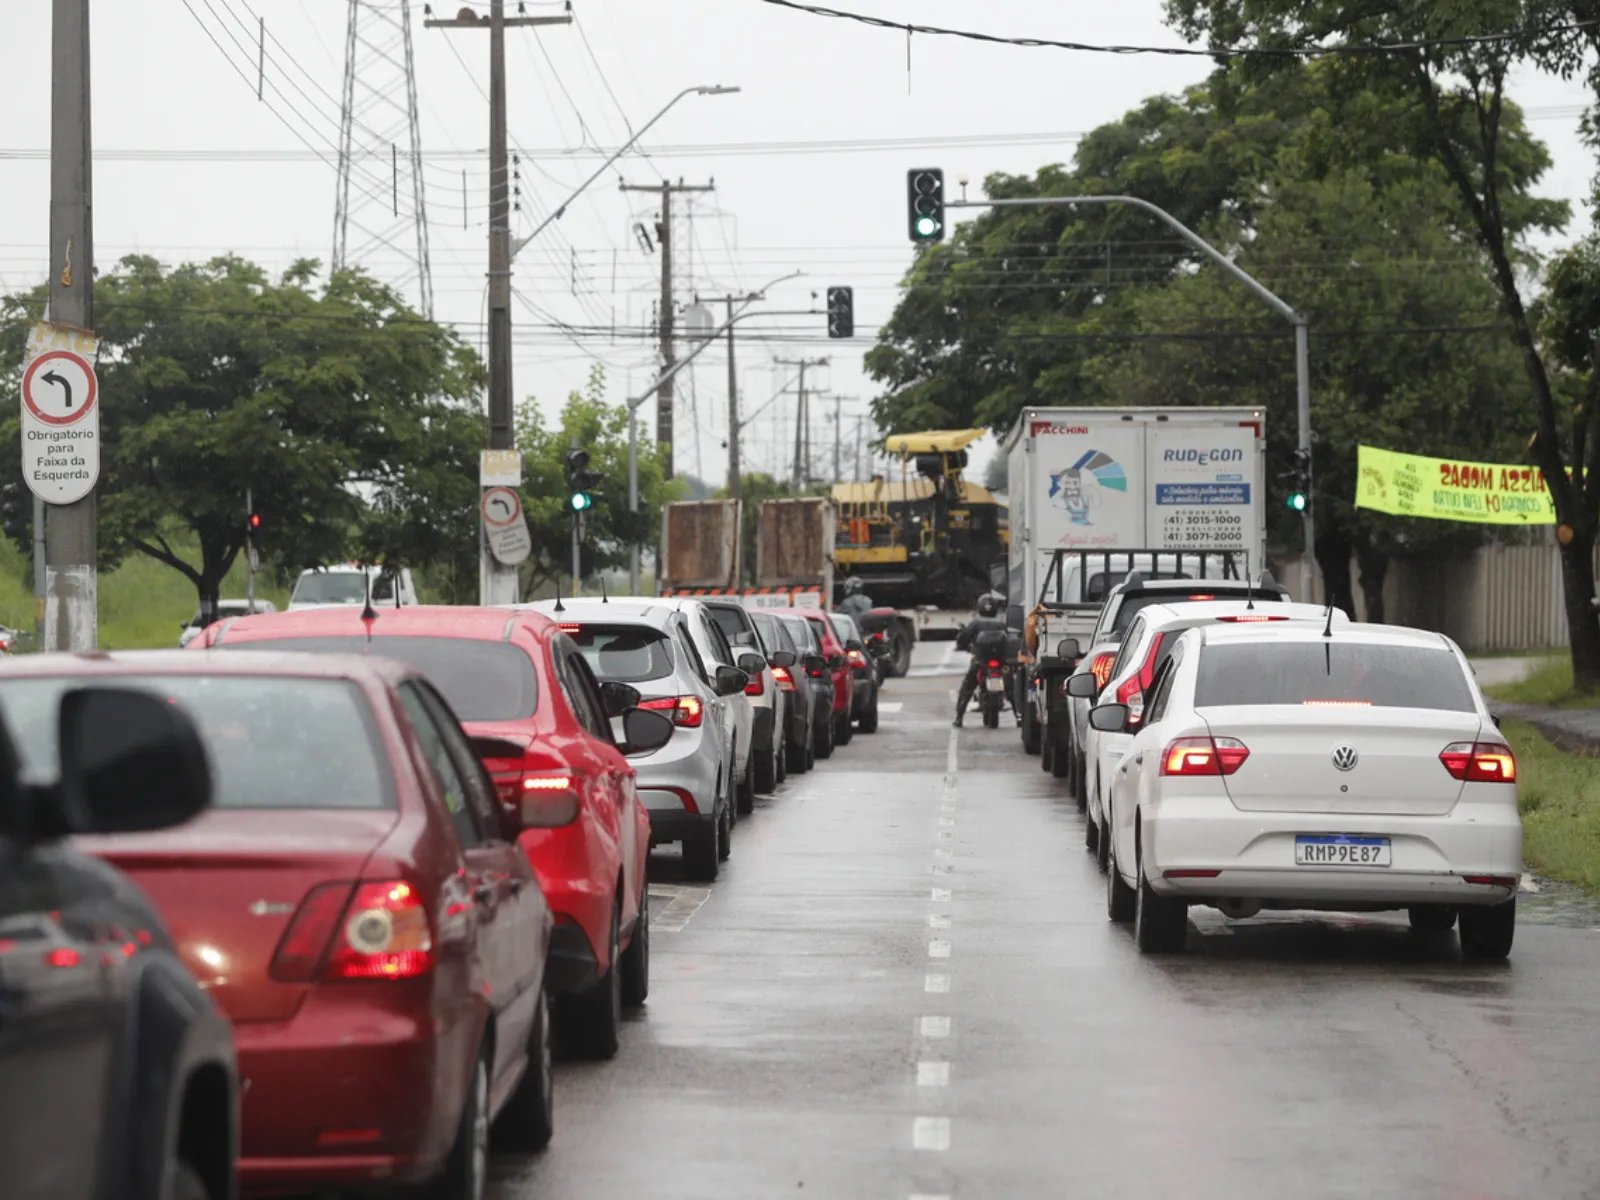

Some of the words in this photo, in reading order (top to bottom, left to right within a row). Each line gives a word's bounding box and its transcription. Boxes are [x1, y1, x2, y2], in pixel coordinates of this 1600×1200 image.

[27, 429, 94, 442] Obrigatório
[47, 444, 74, 455] para
[37, 456, 68, 467] Faixa
[70, 455, 85, 466] da
[33, 469, 89, 482] Esquerda
[1164, 515, 1184, 525] (41)
[1186, 515, 1242, 525] 3015-1000
[1163, 532, 1183, 541] (41)
[1185, 532, 1242, 541] 3071-2000
[1304, 844, 1381, 862] RMP9E87
